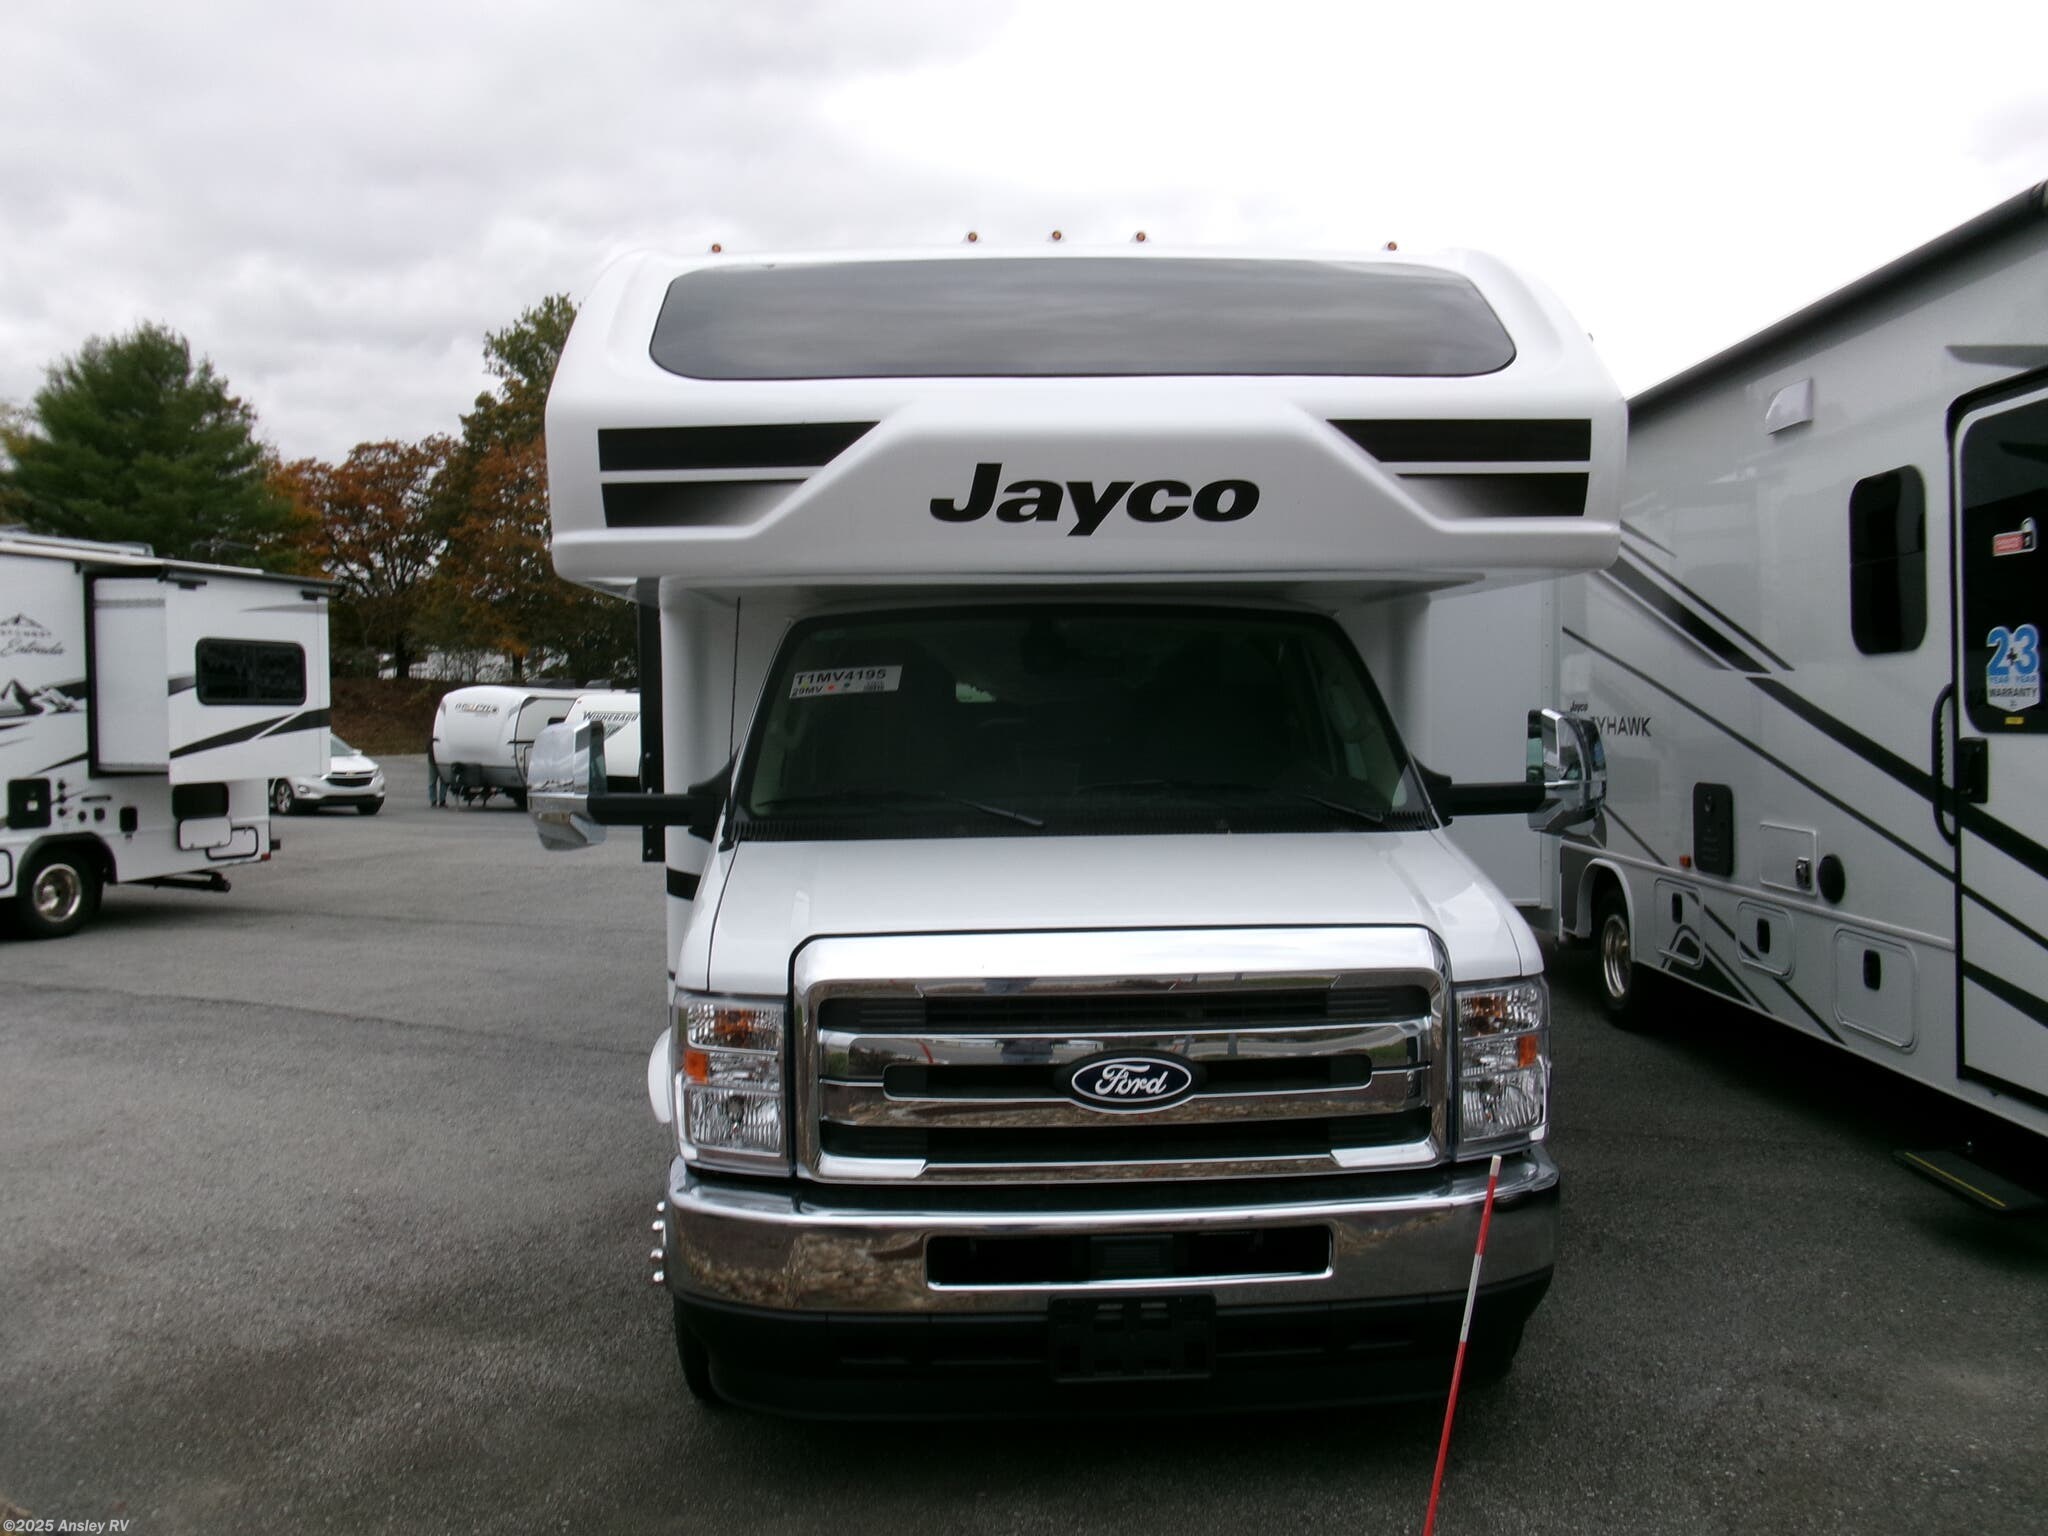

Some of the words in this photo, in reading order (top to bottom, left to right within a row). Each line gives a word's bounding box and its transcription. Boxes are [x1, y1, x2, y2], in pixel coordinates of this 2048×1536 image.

[929, 462, 1260, 536] Jayco
[796, 668, 887, 685] T1MV4195
[1989, 687, 2038, 698] WARRANTY
[1591, 716, 1651, 737] YHAWK
[1095, 1063, 1169, 1095] Ford
